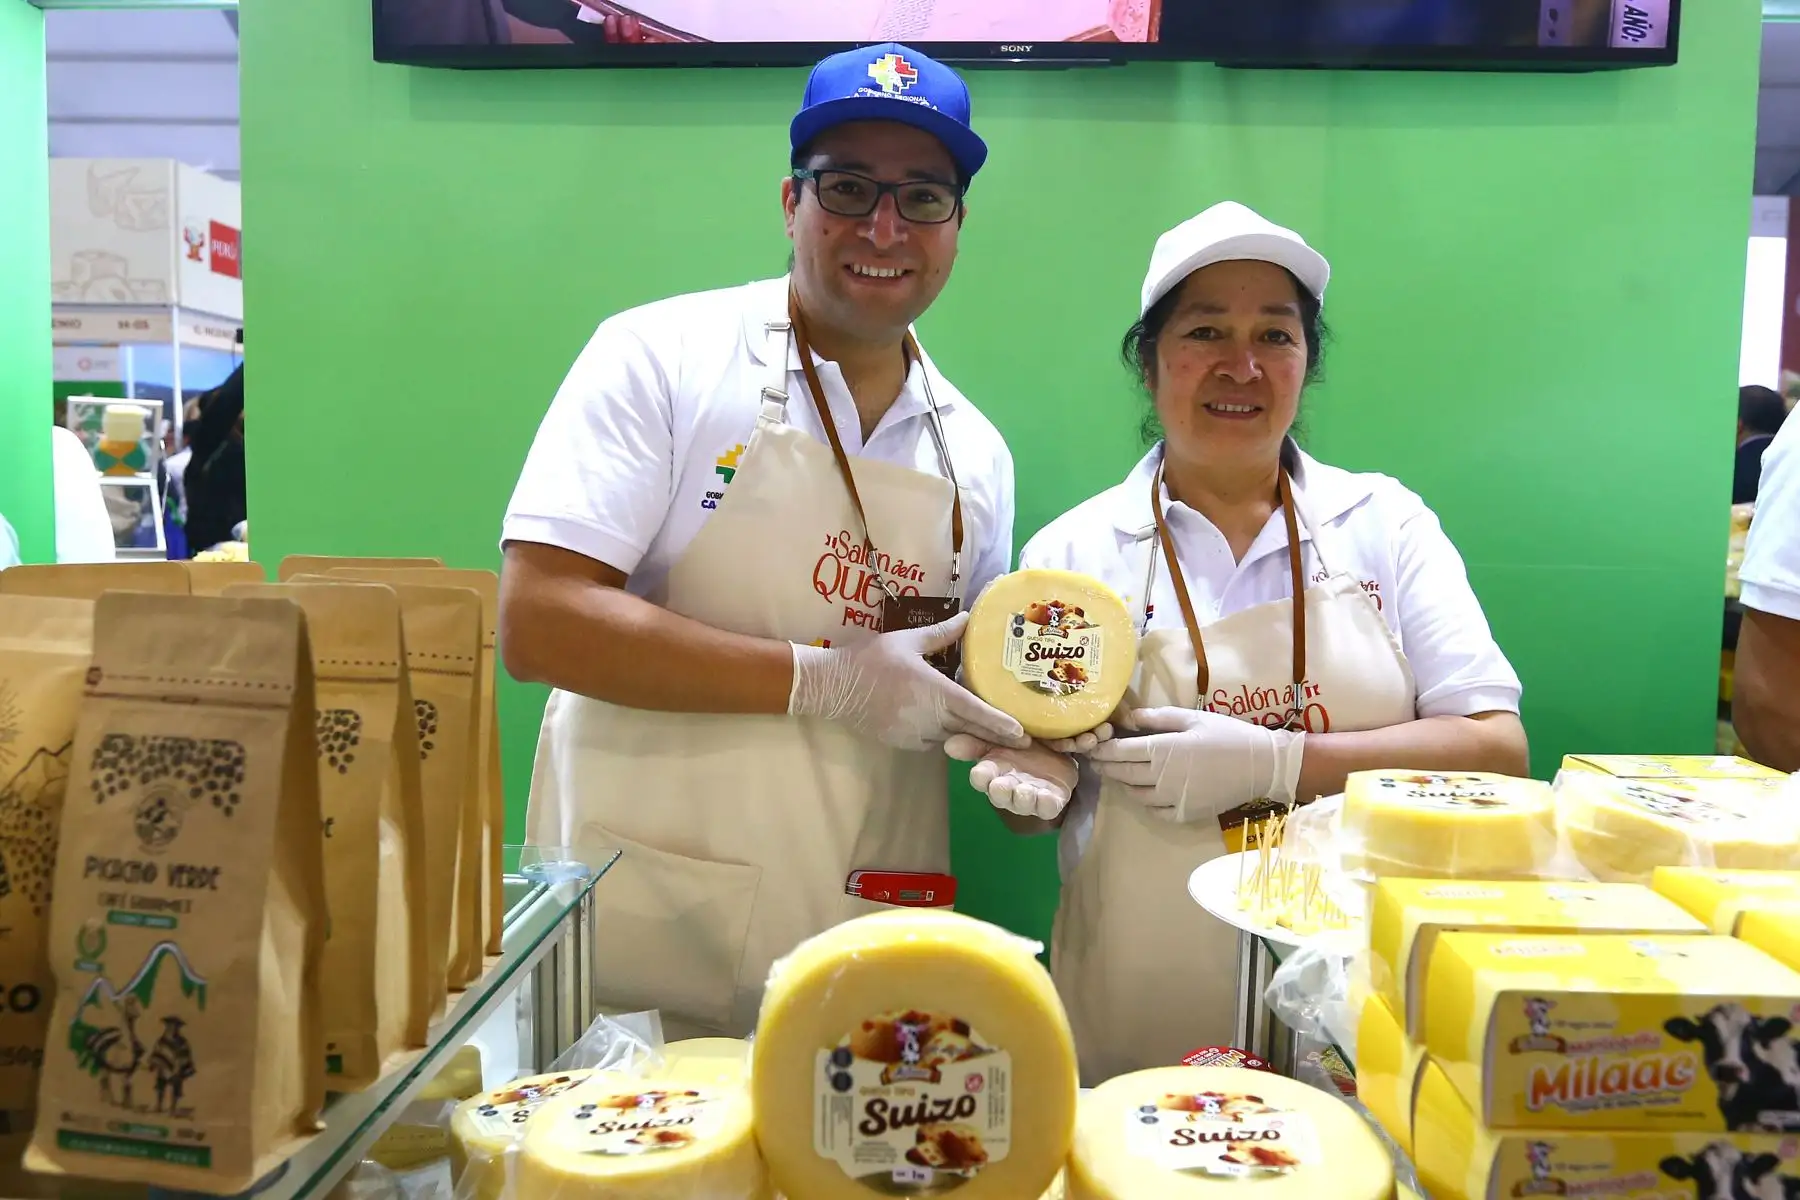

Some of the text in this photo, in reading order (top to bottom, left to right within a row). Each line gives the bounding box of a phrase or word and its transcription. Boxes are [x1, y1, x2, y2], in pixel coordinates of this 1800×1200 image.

[836, 530, 891, 572] Saln
[1025, 642, 1085, 662] Suizo
[1212, 684, 1280, 716] Salón
[1528, 1052, 1696, 1110] Milaac
[589, 1115, 695, 1135] Suizo
[859, 1093, 976, 1136] Suizo
[1169, 1127, 1281, 1146] Suizo
